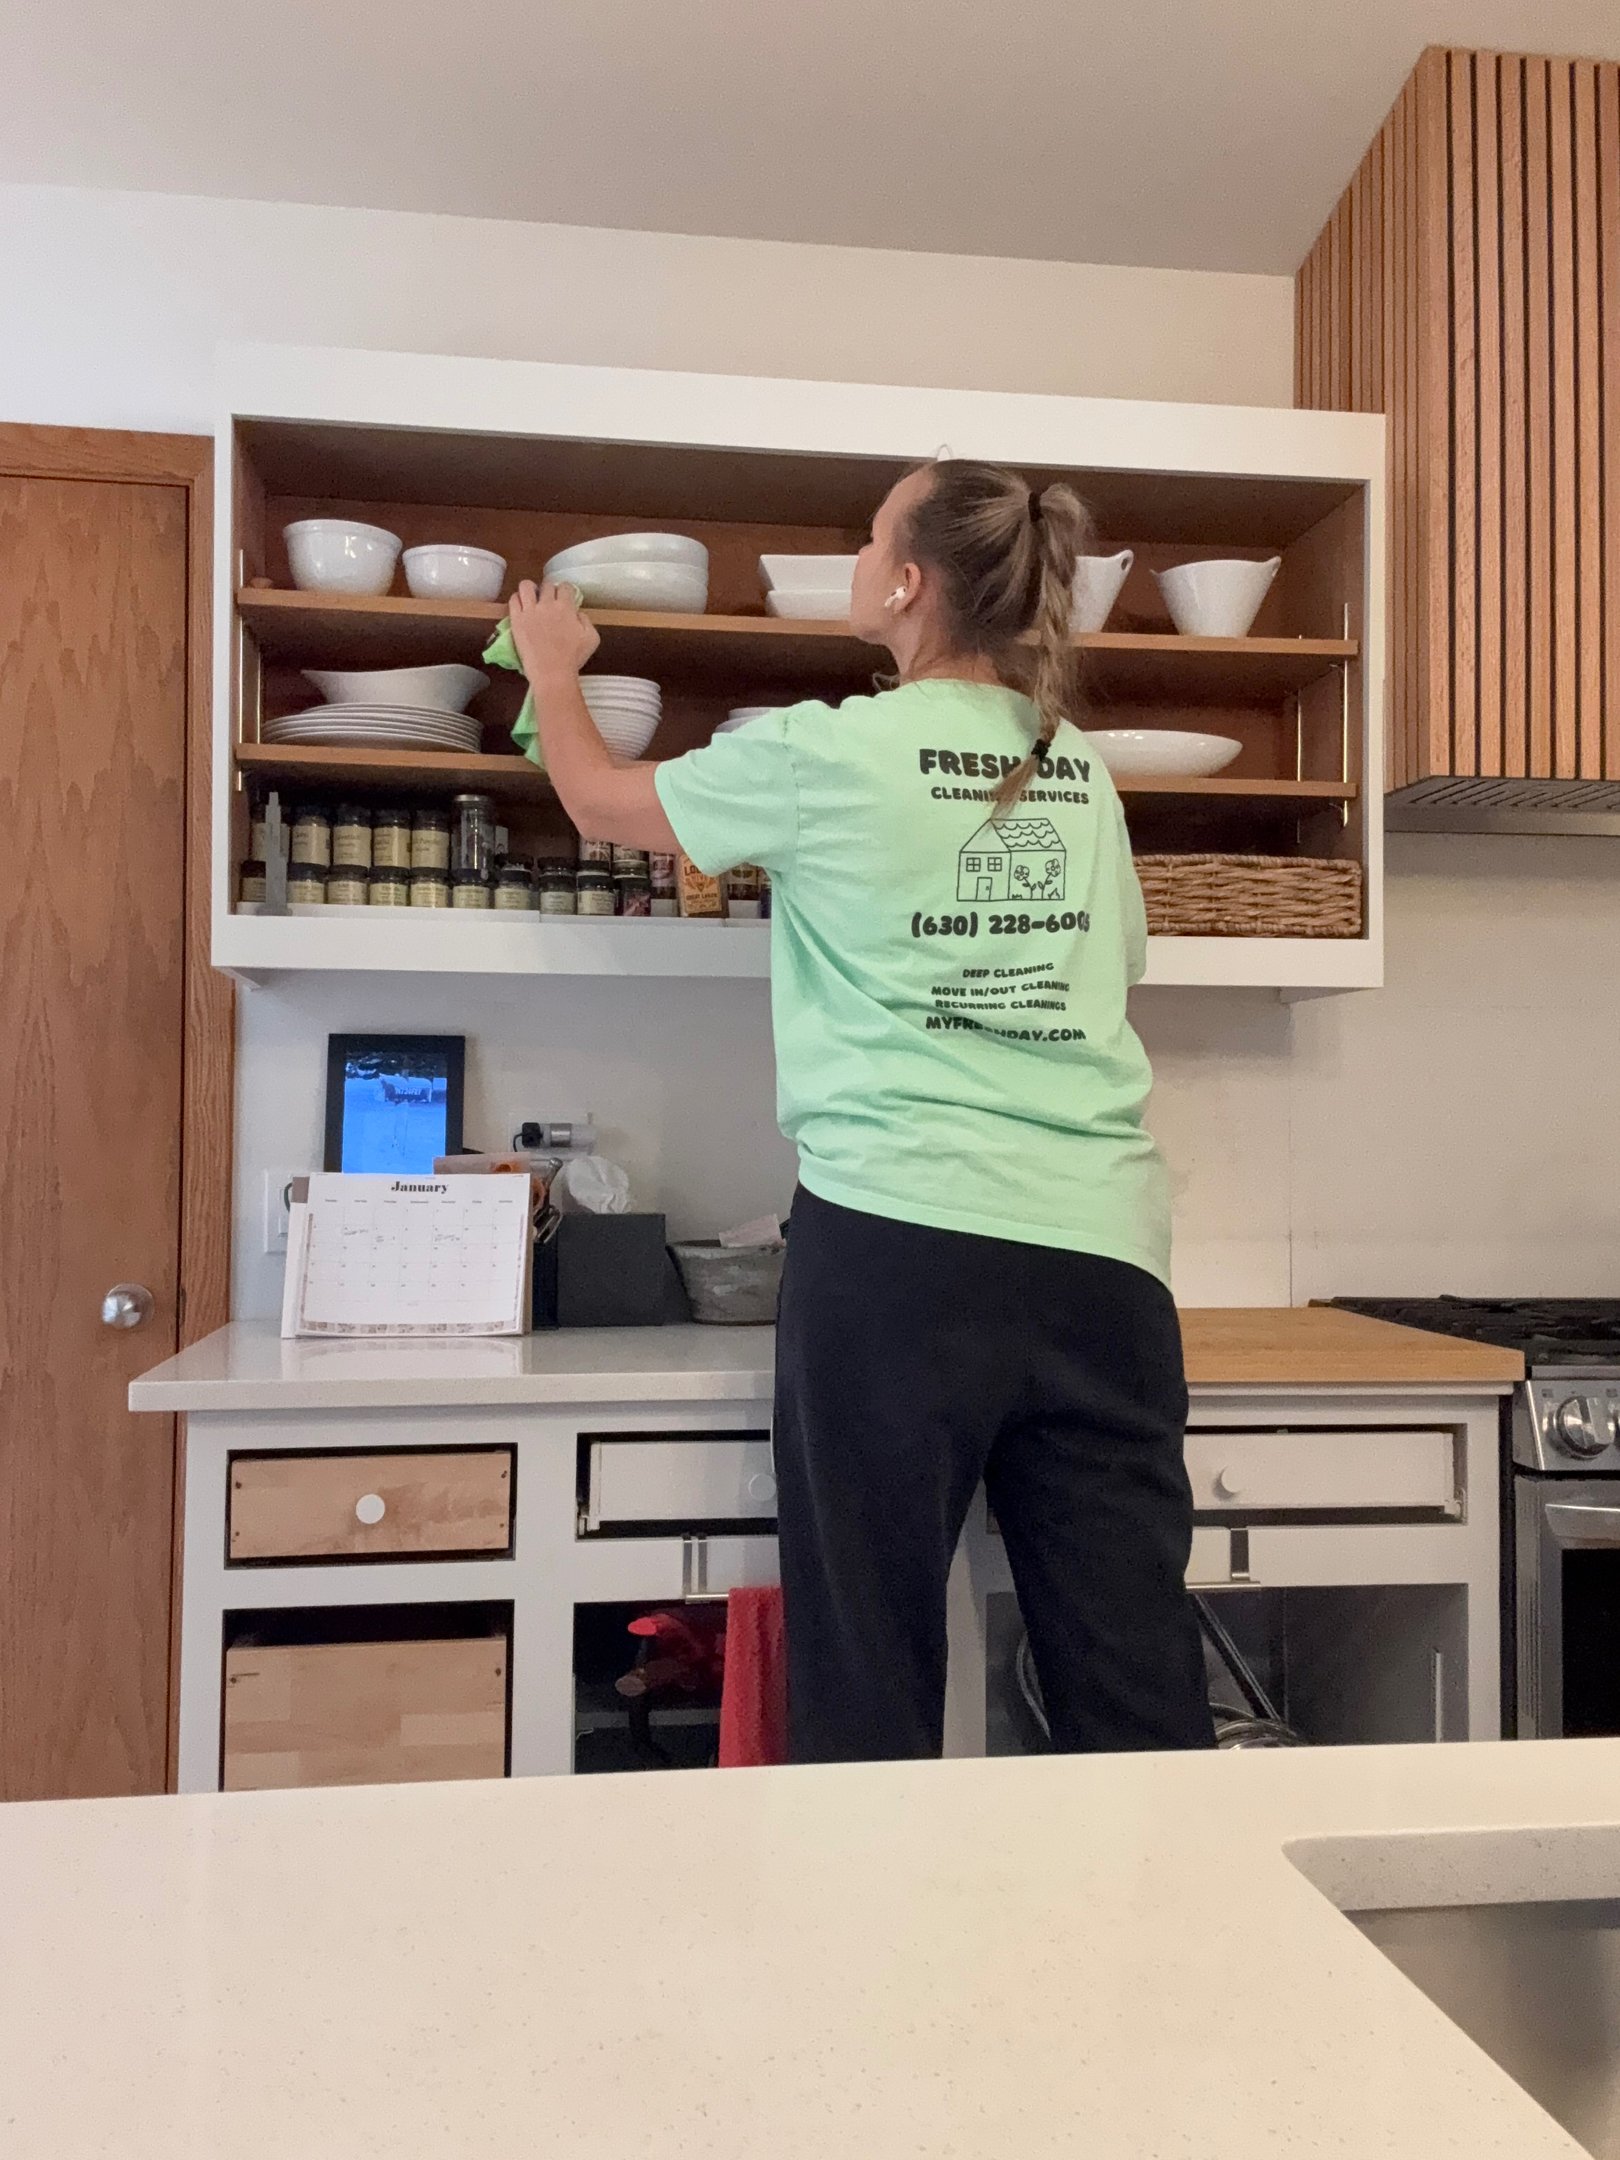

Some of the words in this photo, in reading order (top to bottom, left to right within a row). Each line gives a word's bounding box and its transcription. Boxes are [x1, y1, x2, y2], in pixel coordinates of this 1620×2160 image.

[1036, 756, 1090, 782] DAY
[1019, 790, 1089, 804] SERVICES
[911, 912, 978, 938] (630)
[962, 969, 990, 978] DEEP
[993, 963, 1054, 978] CLEANING
[931, 986, 967, 996] MOVE
[970, 985, 1017, 997] IN/OUT
[935, 999, 1006, 1010] RECURRING
[1010, 999, 1066, 1011] CLEANINGS
[390, 1181, 449, 1195] January
